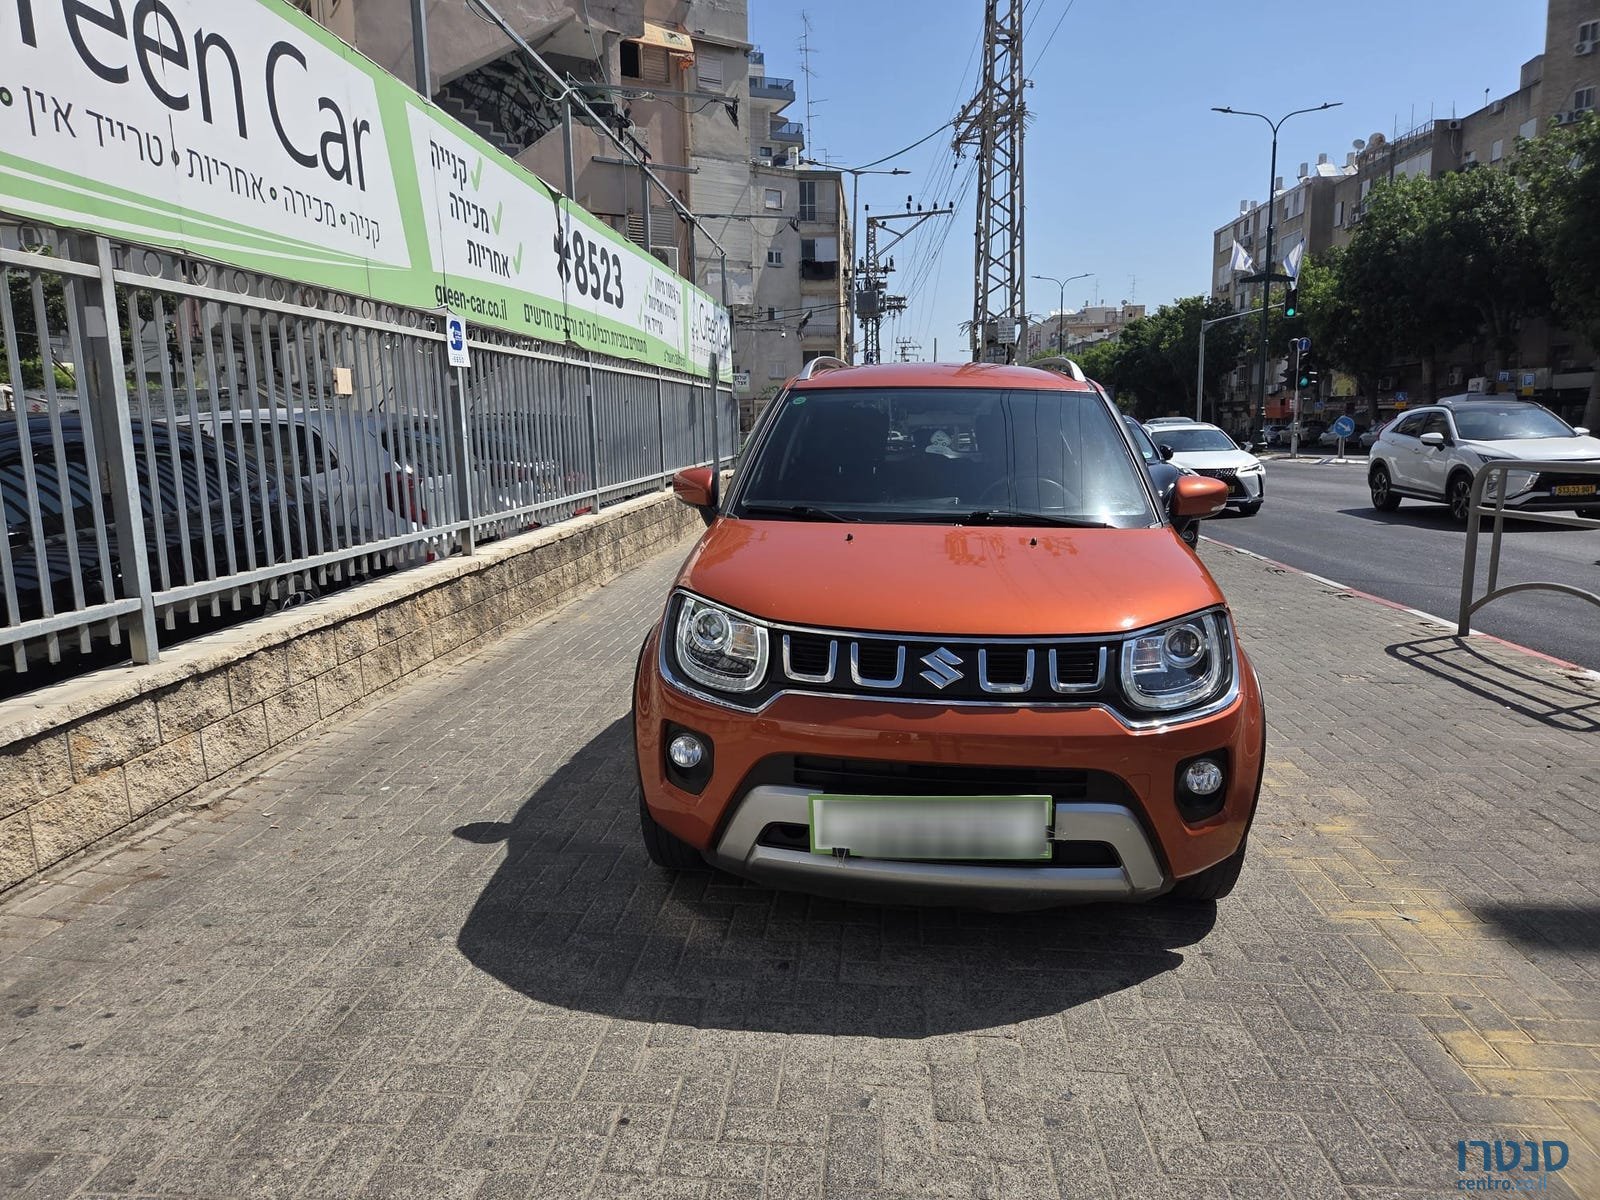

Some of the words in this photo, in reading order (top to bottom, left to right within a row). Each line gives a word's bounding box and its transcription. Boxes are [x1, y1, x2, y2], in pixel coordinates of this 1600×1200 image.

[22, 85, 77, 137] אין
[265, 40, 371, 192] Car
[85, 109, 164, 167] טרייד
[186, 147, 266, 204] אחריות
[429, 139, 467, 192] קנייה
[282, 185, 337, 228] מכירה
[449, 191, 490, 235] מכירה
[349, 210, 380, 249] קניה
[466, 239, 511, 279] אחריות
[434, 284, 508, 321] green-car.co.il
[523, 303, 553, 329] חדשים
